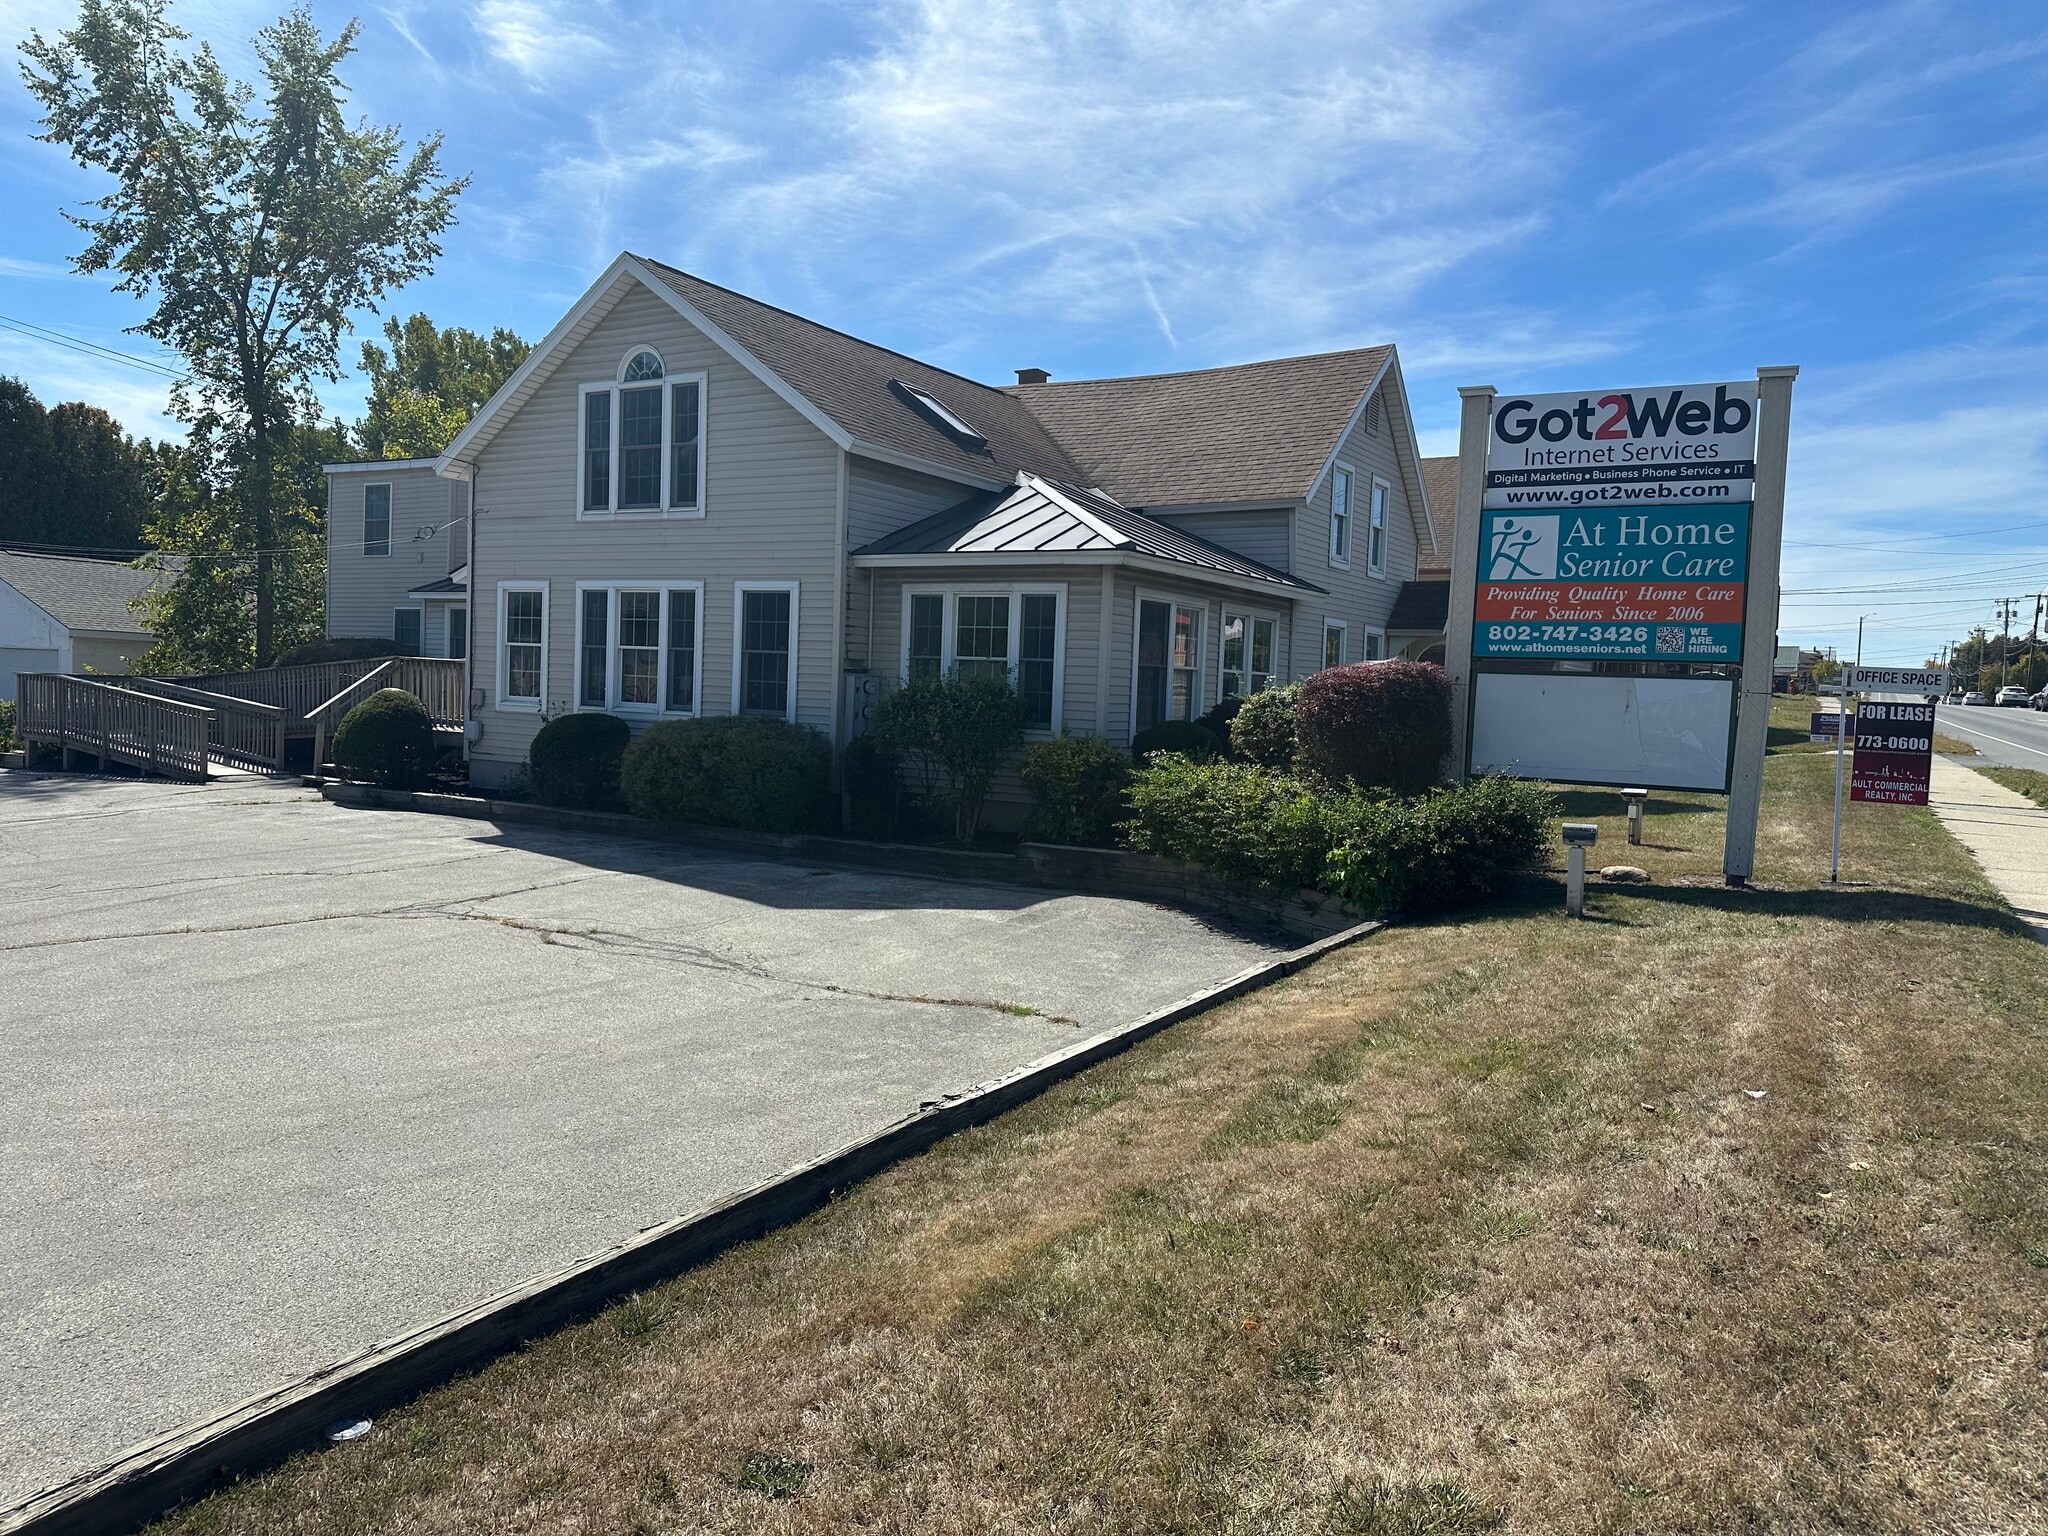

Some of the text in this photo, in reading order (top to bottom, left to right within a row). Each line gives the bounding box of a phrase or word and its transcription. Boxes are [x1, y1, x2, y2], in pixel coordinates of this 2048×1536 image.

[1494, 384, 1752, 444] Got2Web
[1524, 440, 1719, 467] Internet Services
[1494, 464, 1746, 484] Digital Marketing Business Phone Service IT
[1506, 483, 1730, 504] www.got2web.com
[1562, 515, 1735, 547] At Home
[1560, 550, 1734, 577] Senior Care
[1487, 586, 1735, 603] Providing Quality Home Care
[1510, 606, 1704, 621] For Seniors Since 2006
[1488, 625, 1648, 642] 802-747-3426
[1690, 627, 1708, 636] WE
[1488, 643, 1647, 654] www.athomeseniors.net
[1689, 636, 1713, 645] ARE
[1688, 644, 1728, 654] HIRING
[1856, 670, 1942, 686] OFFICE SPACE
[1858, 704, 1887, 720] FOR
[1889, 706, 1933, 722] LEASE
[1857, 735, 1930, 751] 773-0600
[1852, 779, 1928, 793] AULT COMMERCIAL
[1864, 790, 1916, 802] REALTY, INC.
